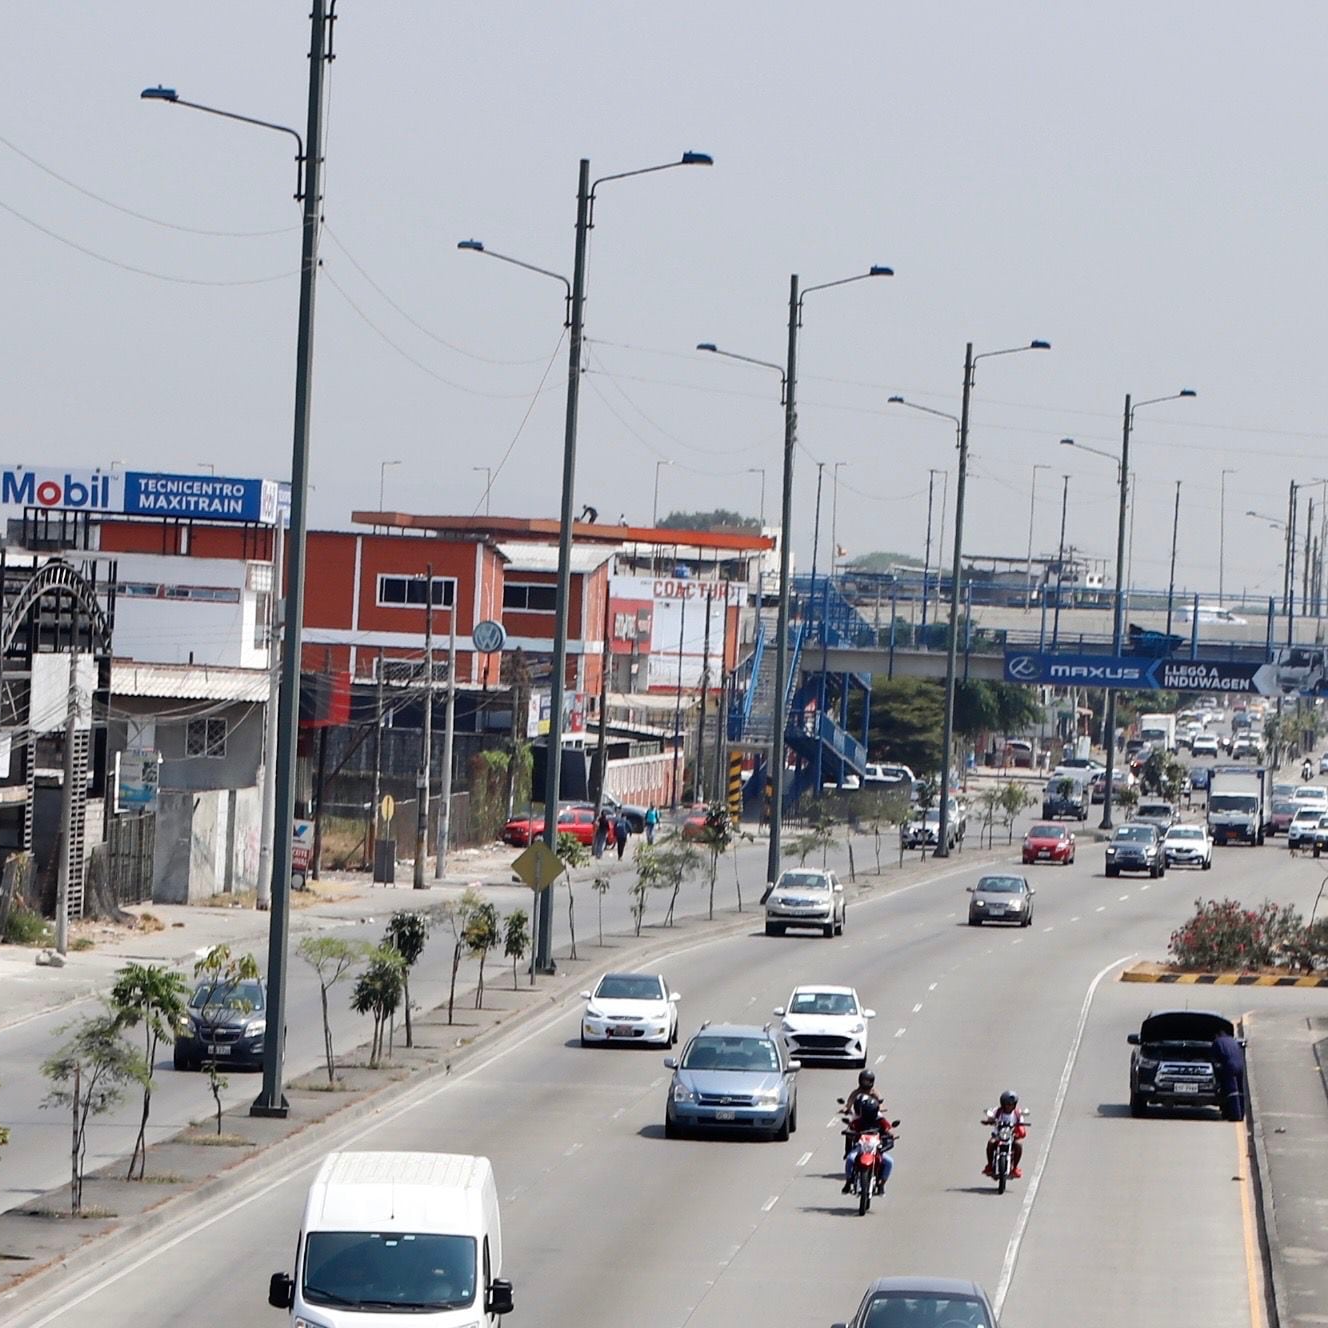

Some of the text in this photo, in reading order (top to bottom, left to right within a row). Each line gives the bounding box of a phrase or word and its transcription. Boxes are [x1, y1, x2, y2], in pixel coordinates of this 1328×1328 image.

[2, 471, 109, 508] Mobil
[139, 478, 244, 497] TECNICENTRO
[138, 494, 242, 513] MAXITRAIN
[1050, 665, 1140, 679] MAXUS
[1165, 664, 1219, 677] LLEGÓ A
[1164, 676, 1250, 691] INDUWAGEN
